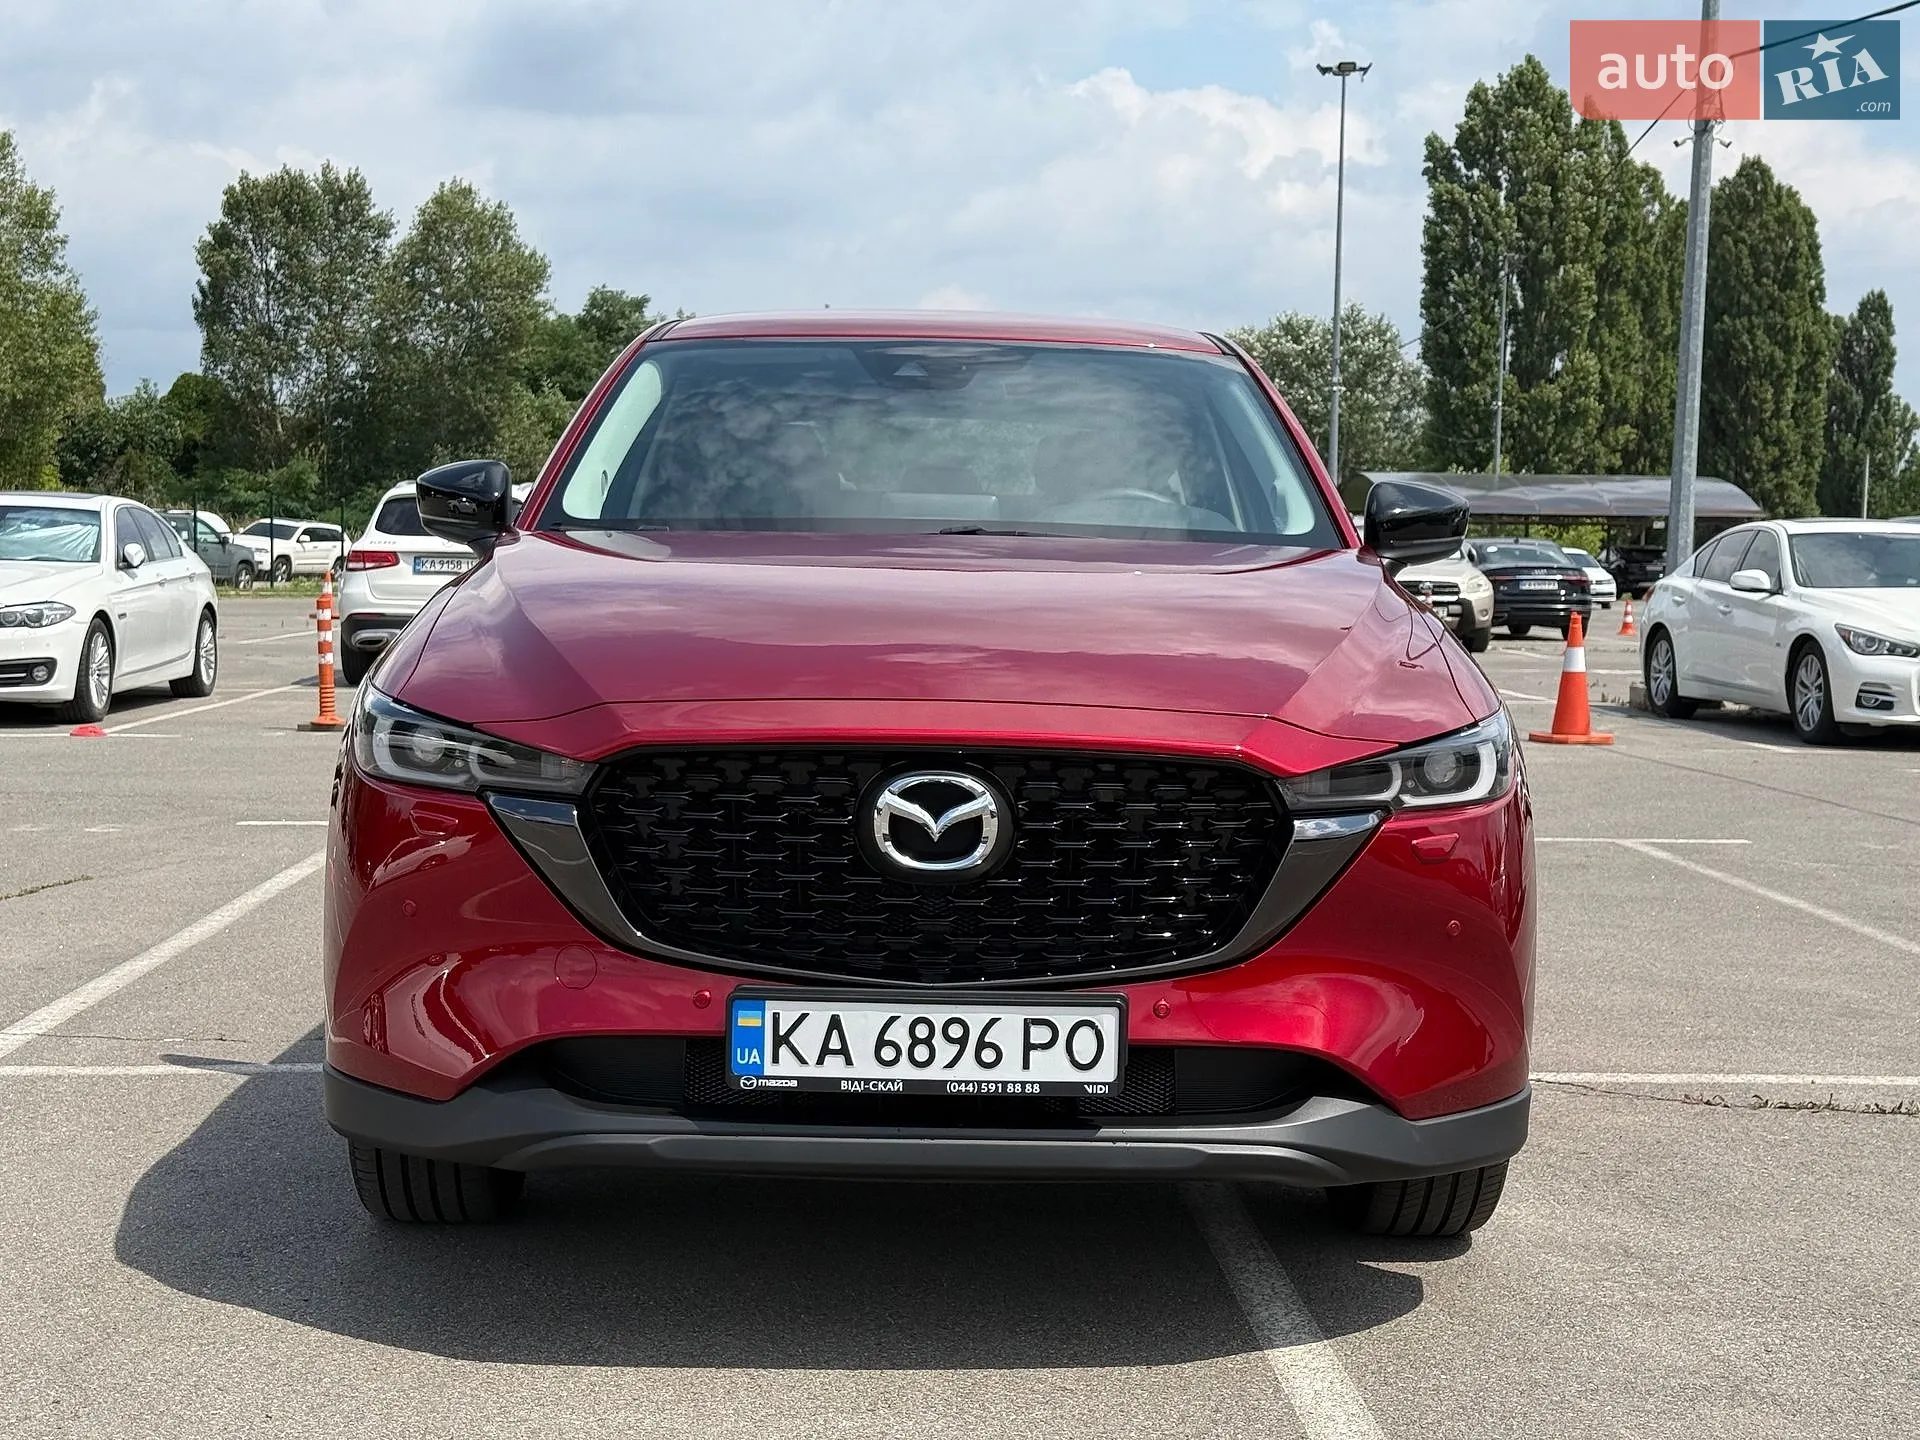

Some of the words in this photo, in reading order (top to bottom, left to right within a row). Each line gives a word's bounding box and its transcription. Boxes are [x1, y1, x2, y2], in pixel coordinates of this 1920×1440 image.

[421, 559, 437, 570] KA
[770, 1011, 855, 1066] KA
[873, 1015, 1004, 1070] 6896
[1021, 1017, 1106, 1071] PO
[736, 1047, 761, 1065] UA
[757, 1078, 799, 1088] mazda
[840, 1078, 904, 1092] ВІДІ-СКАЙ
[946, 1081, 978, 1094] (044)
[980, 1082, 1003, 1094] 591
[1006, 1082, 1022, 1094] 88
[1024, 1082, 1041, 1094] 88
[1083, 1084, 1109, 1095] VIDI
